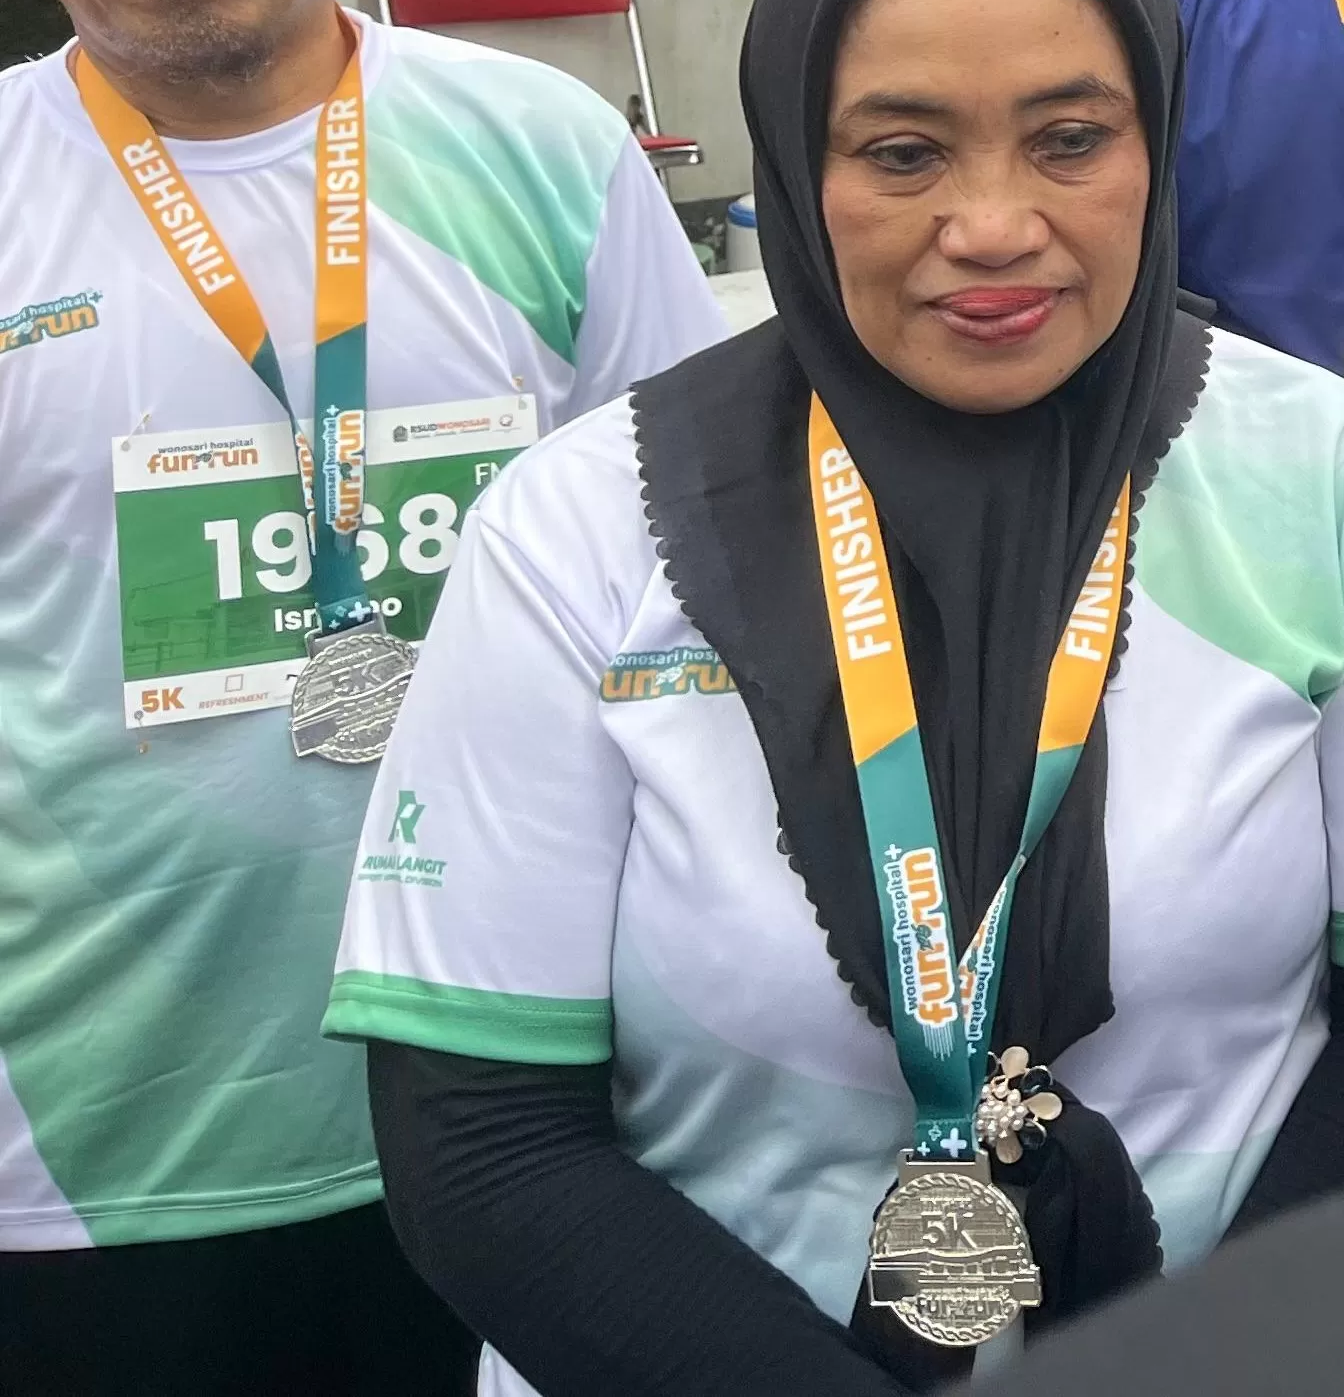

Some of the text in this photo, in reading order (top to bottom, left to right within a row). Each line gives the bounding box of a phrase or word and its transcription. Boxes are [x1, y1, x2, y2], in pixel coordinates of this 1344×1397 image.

[122, 138, 235, 295] FINISHER
[326, 97, 361, 265] FINISHER
[31, 306, 97, 342] run
[147, 448, 258, 474] fun run
[158, 438, 254, 454] wonosari hospital
[819, 446, 892, 662] FINISHER
[141, 687, 184, 713] 5K
[888, 864, 918, 1011] wonosari hospital
[905, 852, 953, 1024] fun run
[982, 890, 1005, 968] wonosari
[968, 969, 989, 1038] hospital
